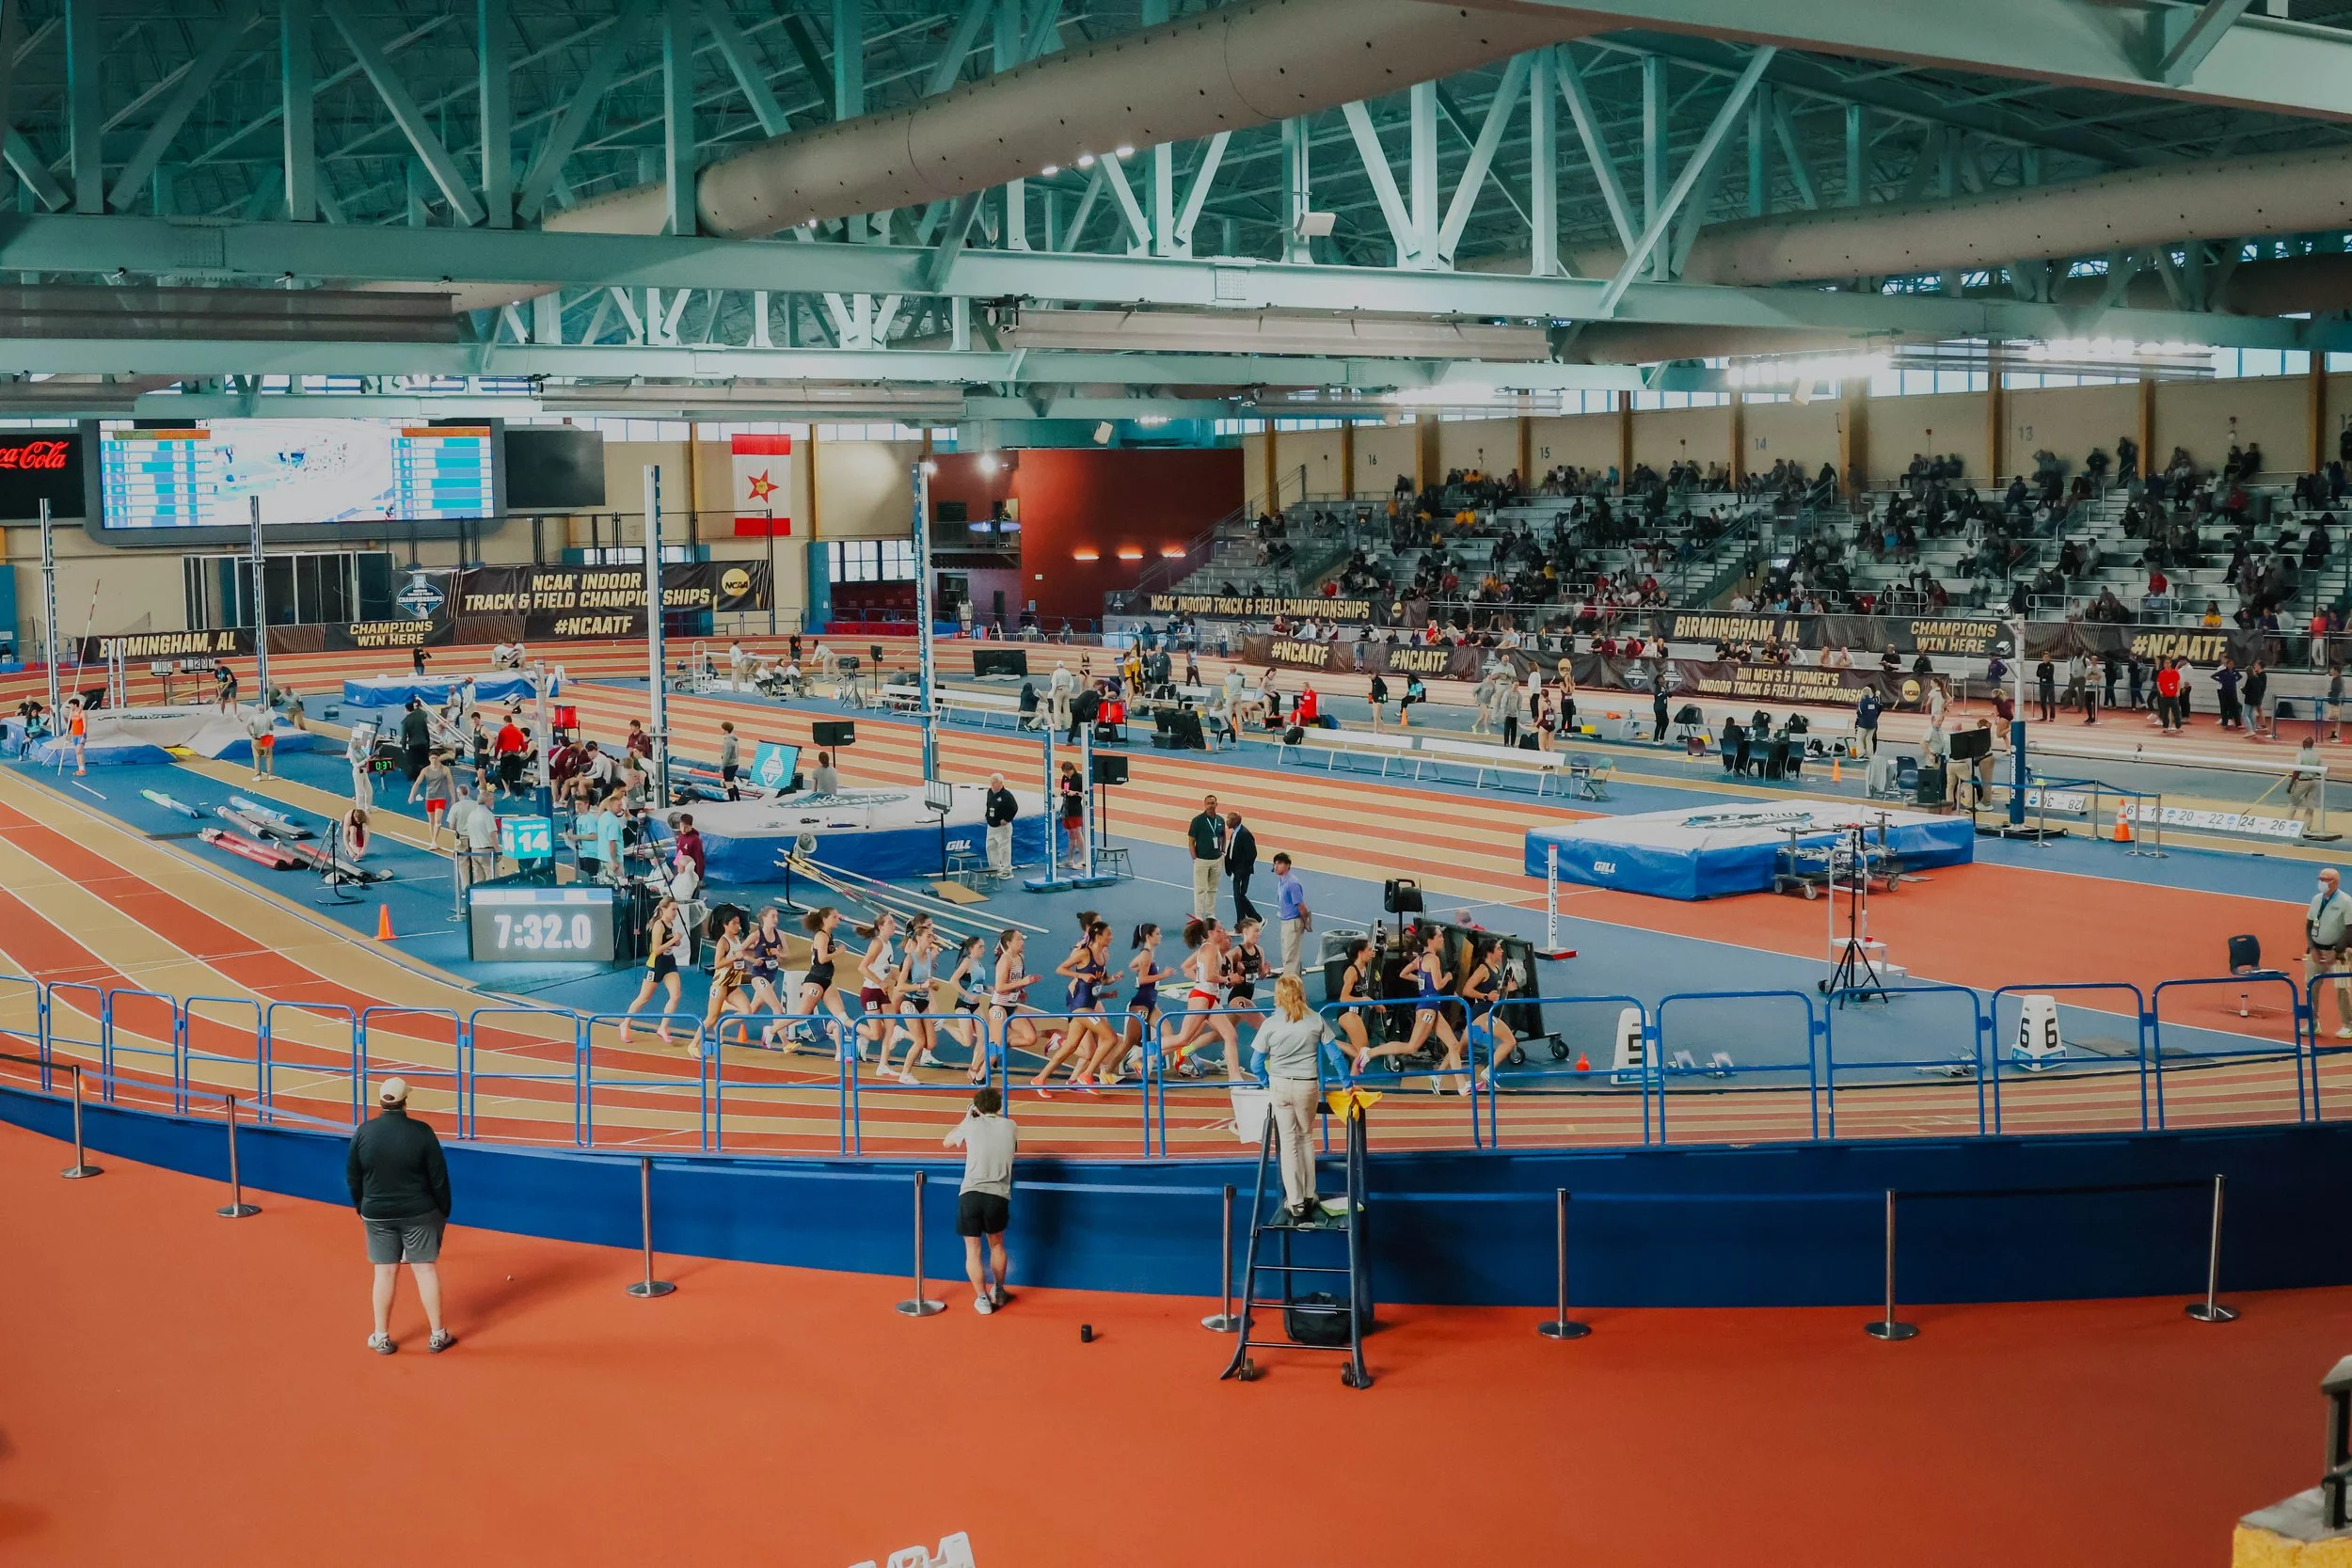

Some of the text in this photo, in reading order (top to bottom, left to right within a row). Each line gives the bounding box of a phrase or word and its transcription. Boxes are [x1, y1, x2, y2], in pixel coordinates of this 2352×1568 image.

[2018, 425, 2033, 441] 13
[1755, 436, 1766, 451] 14
[1369, 454, 1376, 466] 16
[1540, 447, 1550, 459] 15
[532, 572, 641, 591] NCAA INDOOR
[725, 580, 748, 590] NCAA
[465, 588, 710, 610] TRACK & FIELD CHAMPIOSHIPS
[1152, 594, 1370, 619] NCAA INDOOR TRACK & FIELD CHAMPIONSHIPS
[350, 621, 433, 635] CHAMPIONS
[554, 615, 632, 635] #NCAATF
[1781, 620, 1800, 642] AL
[1911, 622, 1997, 638] CHAMPIONS
[216, 631, 235, 650] AL
[358, 633, 424, 647] WIN HERE
[1916, 637, 1986, 653] WIN HERE
[2130, 633, 2228, 661] #NCAATF
[1271, 642, 1329, 666] #NCAATF
[1390, 649, 1448, 672] #NCAATF
[1754, 669, 1784, 683] MEN'S
[1784, 671, 1790, 683] &
[1792, 671, 1839, 686] WOMEN'S
[1698, 679, 1731, 693] INDOOR
[1733, 681, 1762, 696] TRACK
[1763, 684, 1770, 696] &
[1772, 684, 1796, 698] FIELD
[375, 760, 392, 770] 0:37
[2179, 811, 2194, 821] 20
[2209, 814, 2224, 825] 22
[2240, 816, 2256, 828] 24
[2270, 820, 2286, 831] 26
[518, 832, 549, 852] 14
[946, 840, 971, 851] GILL
[1593, 861, 1616, 874] GILL
[494, 913, 592, 949] 7:32.0
[760, 979, 766, 988] 9
[2020, 1017, 2058, 1049] 6 6
